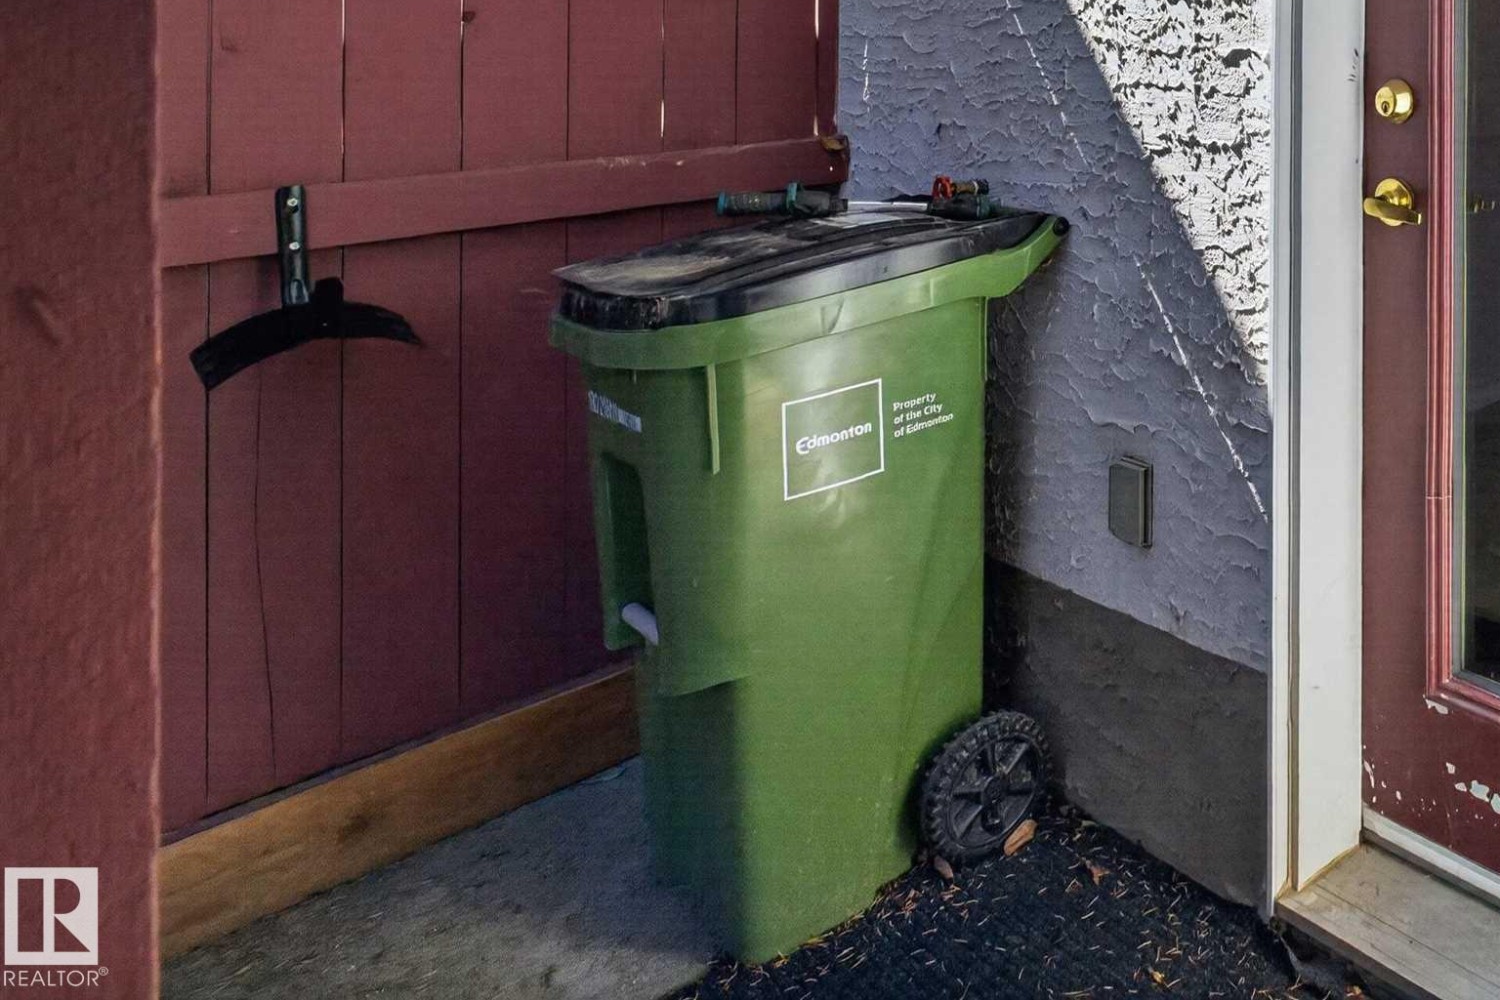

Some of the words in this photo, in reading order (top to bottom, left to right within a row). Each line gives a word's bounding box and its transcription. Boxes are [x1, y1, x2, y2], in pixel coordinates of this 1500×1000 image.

[893, 392, 937, 411] Property
[893, 415, 904, 425] of
[905, 409, 922, 421] the
[923, 402, 944, 416] City
[893, 428, 905, 438] of
[905, 412, 954, 435] Edmonton
[795, 422, 873, 455] Edmonton
